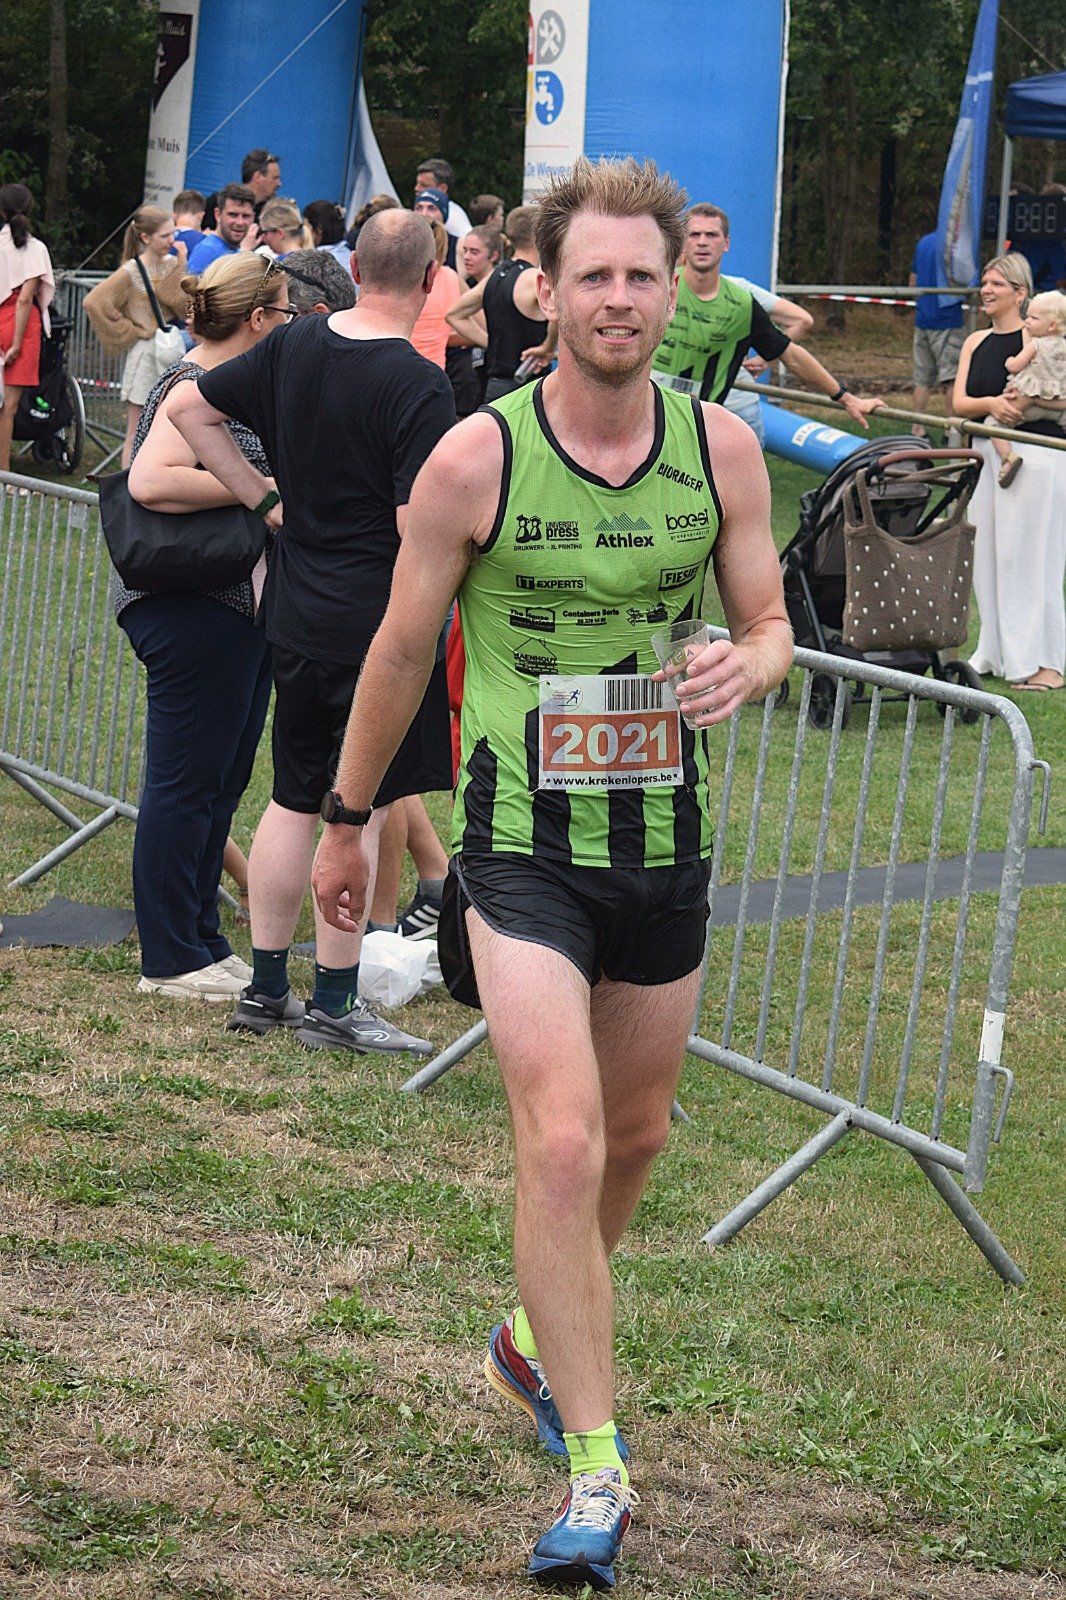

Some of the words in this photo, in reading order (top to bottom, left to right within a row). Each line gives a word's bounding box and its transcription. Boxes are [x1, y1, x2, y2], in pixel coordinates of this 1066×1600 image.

[158, 137, 180, 153] Muis
[657, 462, 704, 493] BIORACER
[546, 521, 579, 529] UNIVERSITY
[546, 527, 579, 541] press
[595, 532, 655, 548] Athlex
[513, 544, 545, 552] DRUKWERK
[517, 576, 534, 589] IT
[537, 579, 584, 589] EXPERTS
[562, 610, 601, 618] Containers
[550, 720, 668, 765] 2021
[552, 773, 673, 786] www.krekenlopers.be
